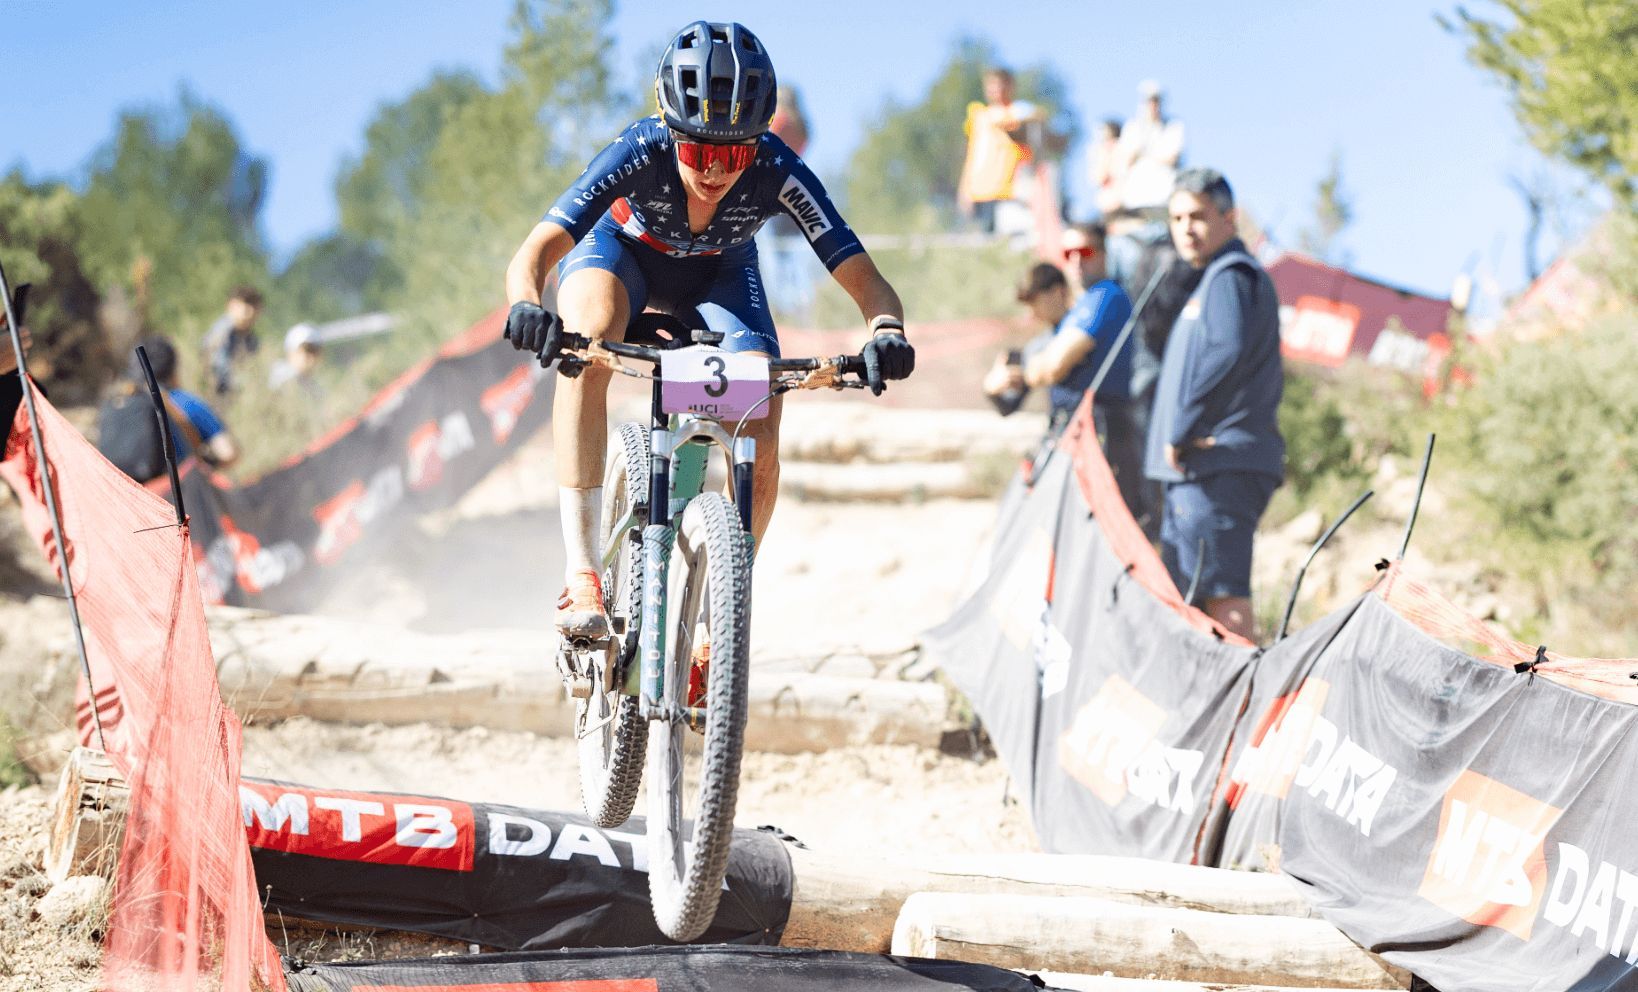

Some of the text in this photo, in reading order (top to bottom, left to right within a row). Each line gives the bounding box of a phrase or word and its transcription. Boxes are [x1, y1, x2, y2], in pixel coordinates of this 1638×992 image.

[696, 127, 744, 136] ROCKRIDER
[572, 154, 651, 207] ROCKRIDER
[782, 186, 826, 233] MAVIC
[704, 356, 729, 397] 3
[647, 558, 664, 680] MANITOU
[1294, 714, 1398, 838] DATA
[238, 785, 457, 849] MTB
[1543, 842, 1638, 968] DAT
